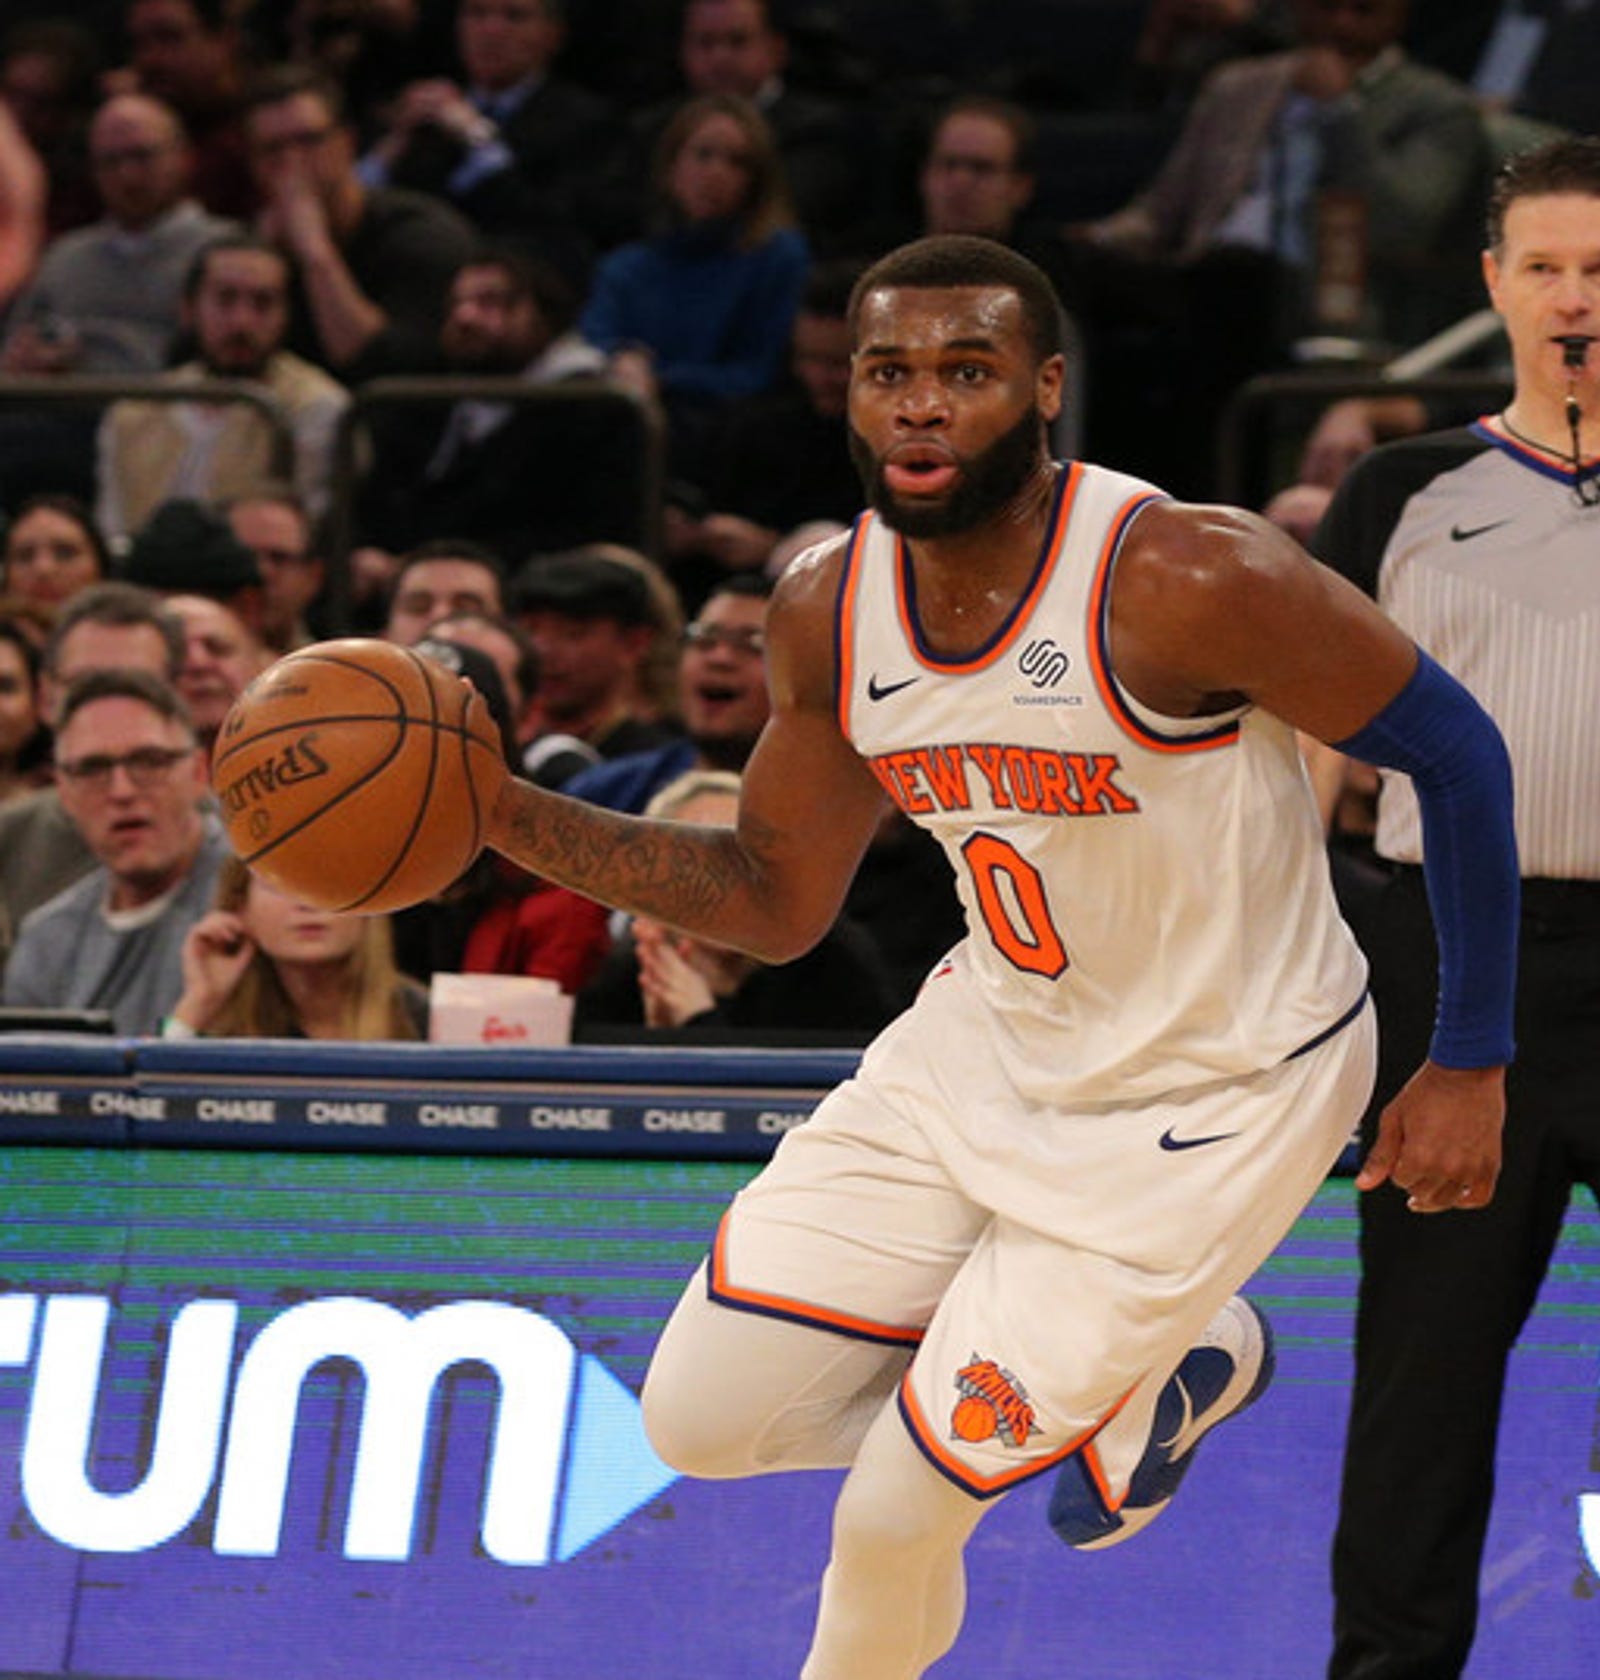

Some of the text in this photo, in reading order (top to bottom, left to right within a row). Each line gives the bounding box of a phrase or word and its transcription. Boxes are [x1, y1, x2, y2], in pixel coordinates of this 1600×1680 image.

[963, 742, 1141, 816] YORK
[960, 831, 1070, 981] 0
[198, 1099, 276, 1123] CHASE
[306, 1101, 387, 1126] CHASE
[418, 1104, 499, 1128] CHASE
[530, 1106, 611, 1131] CHASE
[643, 1109, 726, 1133] CHASE
